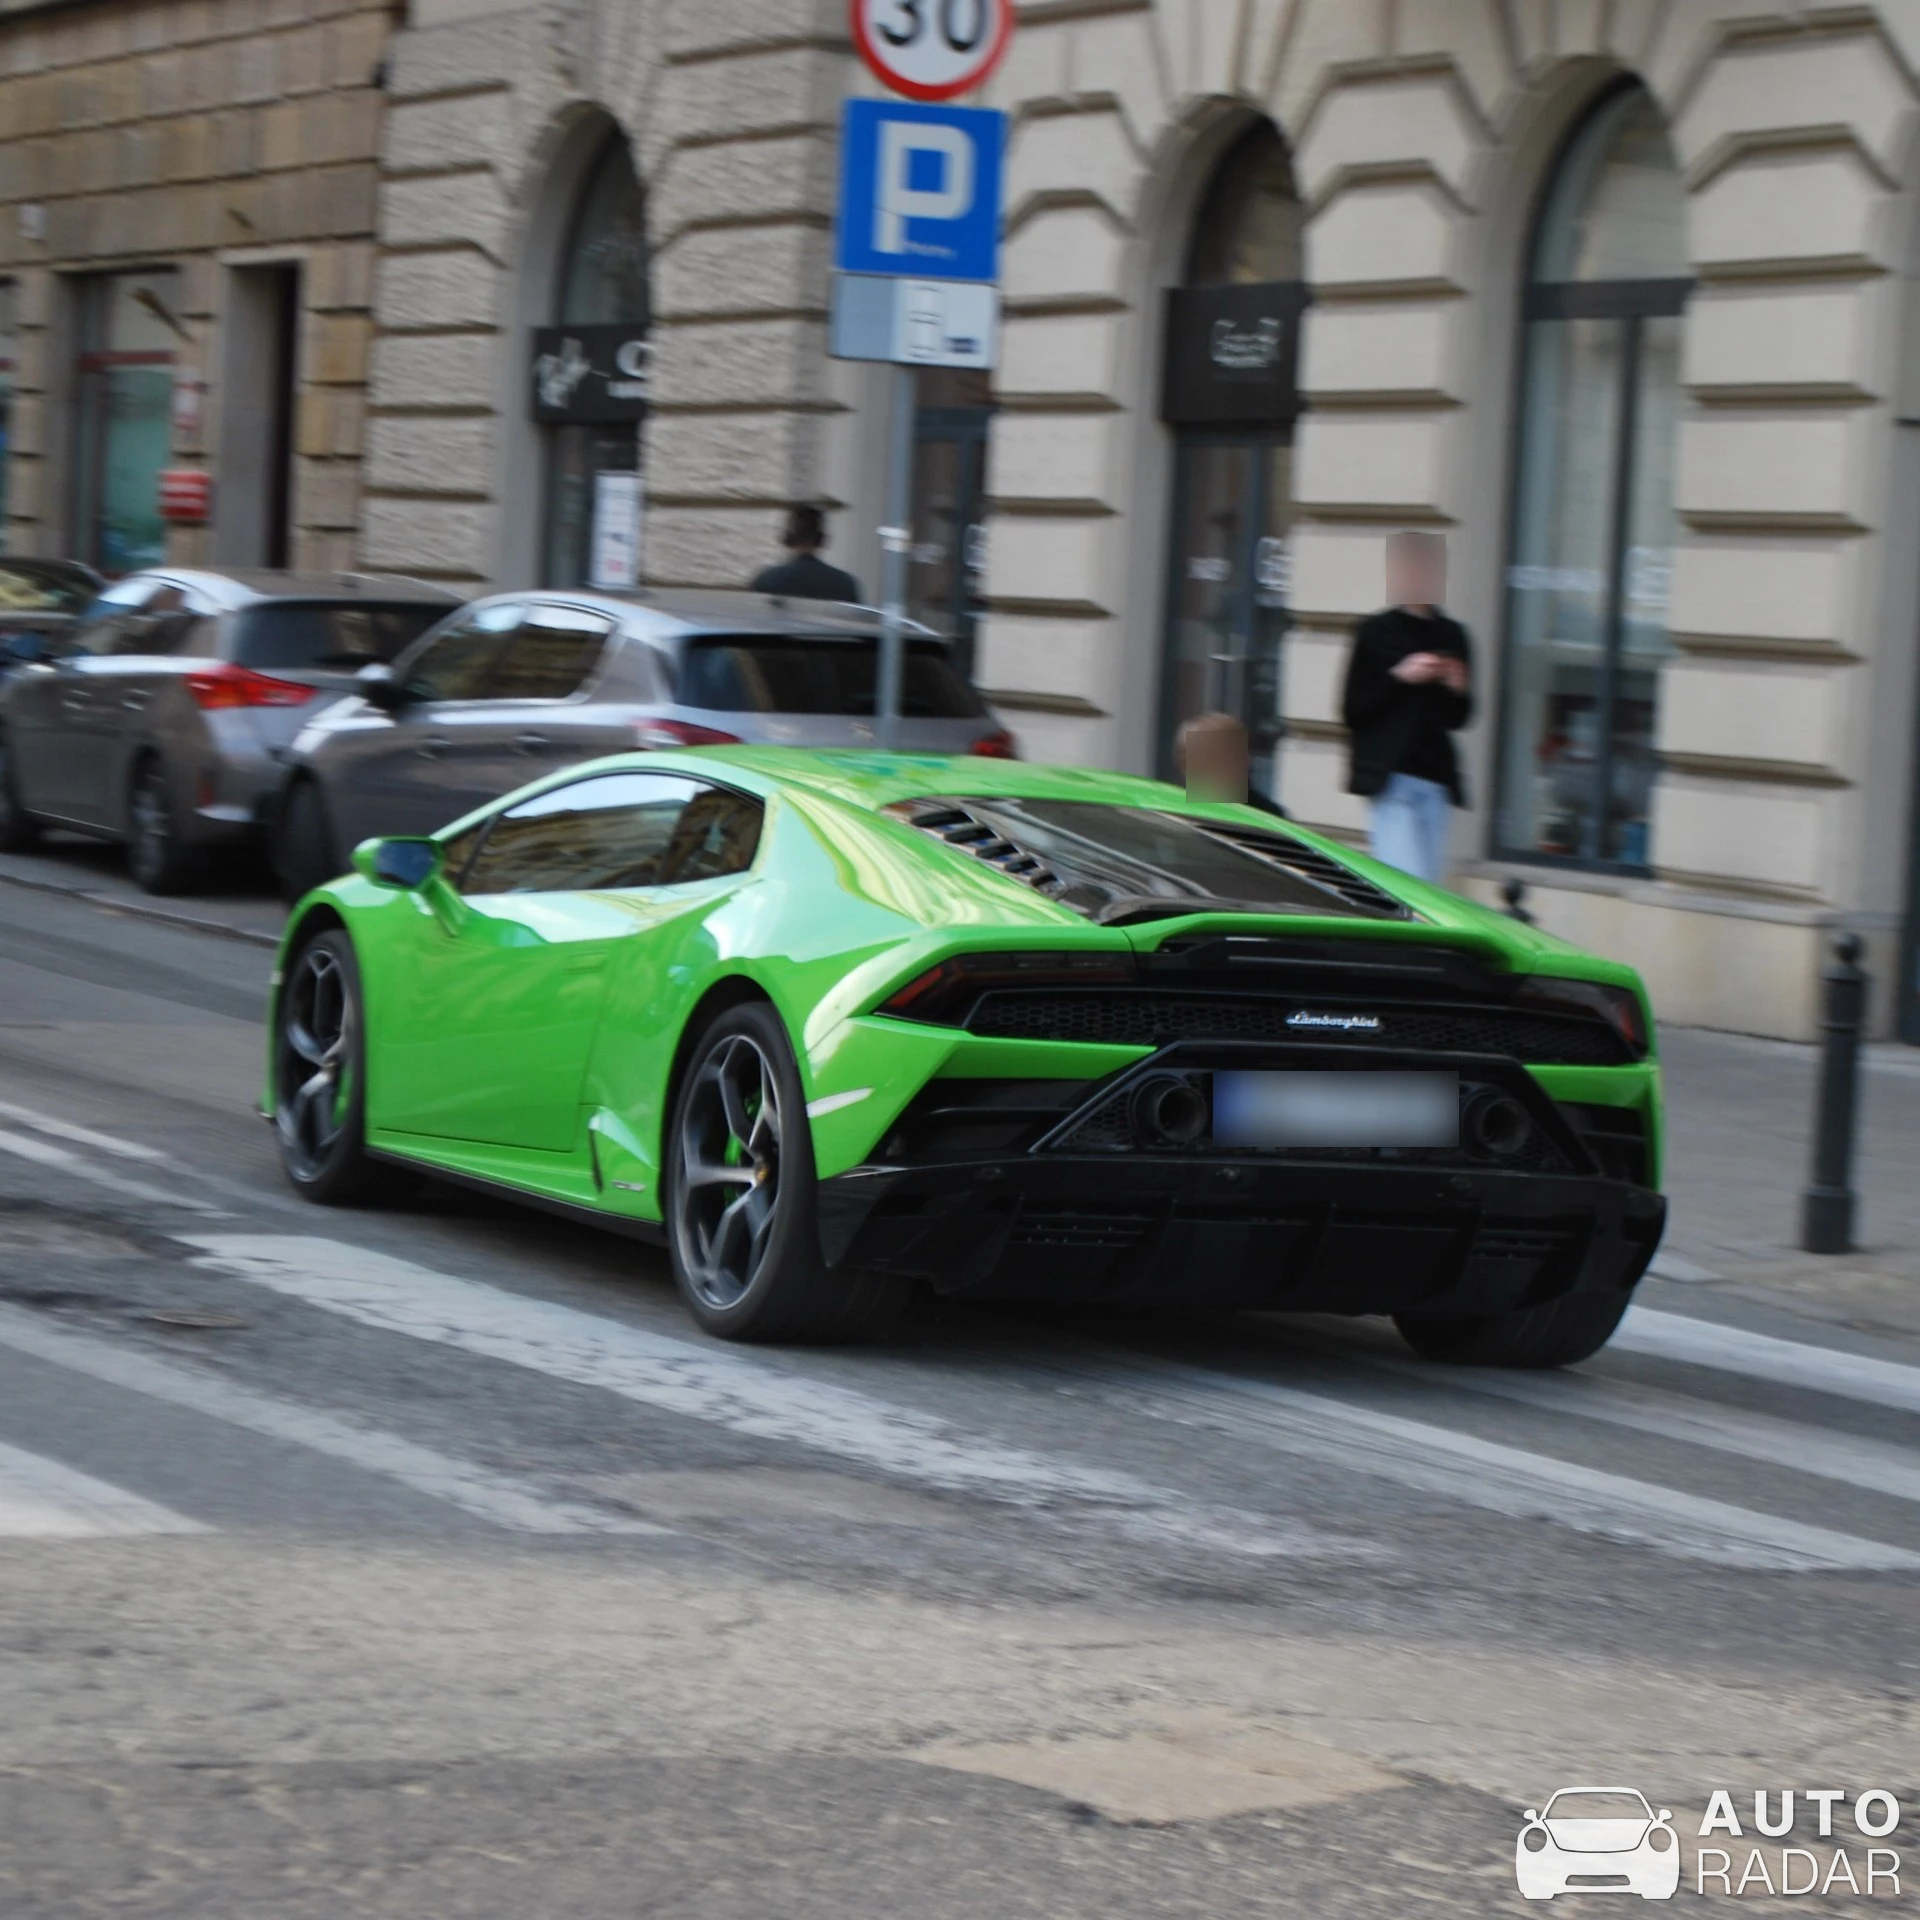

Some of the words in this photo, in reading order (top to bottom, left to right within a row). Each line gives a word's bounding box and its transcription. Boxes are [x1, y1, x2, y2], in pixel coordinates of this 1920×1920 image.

[876, 0, 988, 50] 30
[874, 120, 977, 255] P
[1286, 1011, 1380, 1029] Lamborghini
